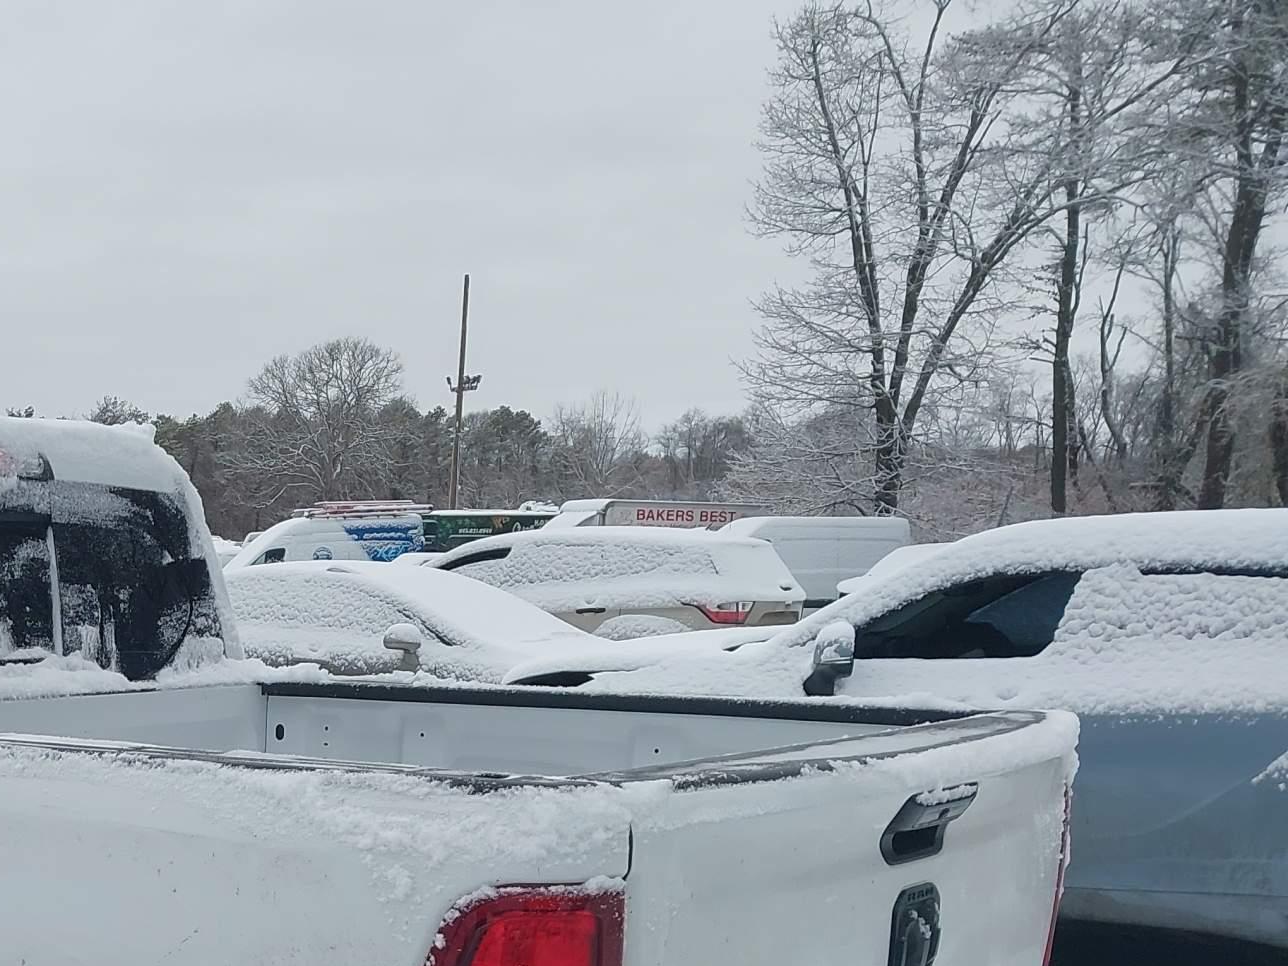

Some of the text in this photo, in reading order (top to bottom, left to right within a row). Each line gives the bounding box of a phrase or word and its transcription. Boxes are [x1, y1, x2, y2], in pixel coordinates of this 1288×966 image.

[636, 509, 737, 523] BAKERS BEST
[907, 886, 935, 902] RAM
